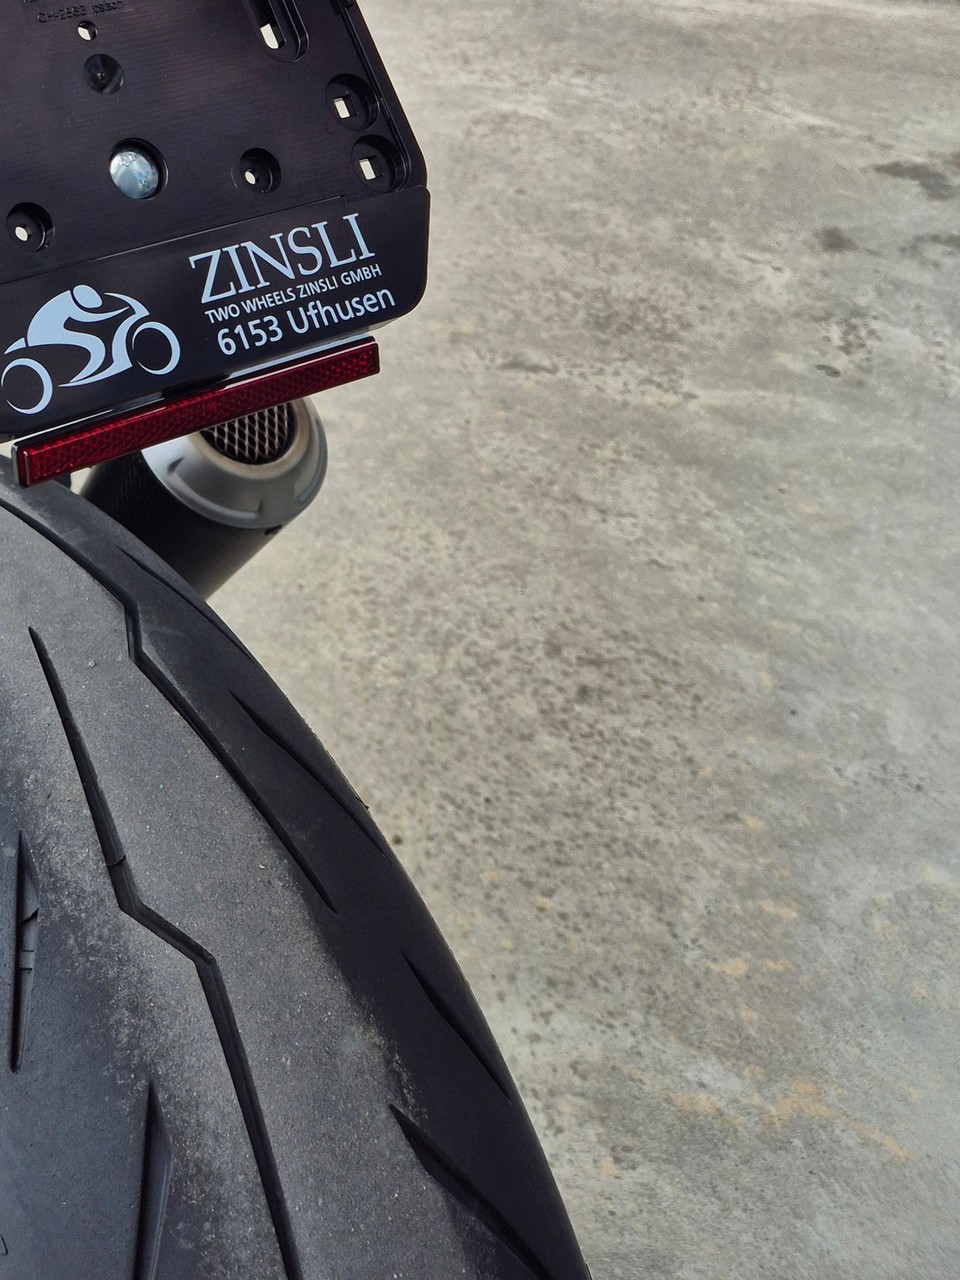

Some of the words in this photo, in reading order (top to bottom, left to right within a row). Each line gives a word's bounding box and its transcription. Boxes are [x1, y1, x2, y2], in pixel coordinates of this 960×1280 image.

[188, 213, 376, 304] ZINSLI
[205, 303, 241, 324] TWO
[241, 288, 296, 315] WHEELS
[296, 275, 339, 299] ZINSLI
[341, 263, 383, 286] GMBH
[217, 315, 284, 356] 6153
[286, 288, 396, 335] Ufhusen
